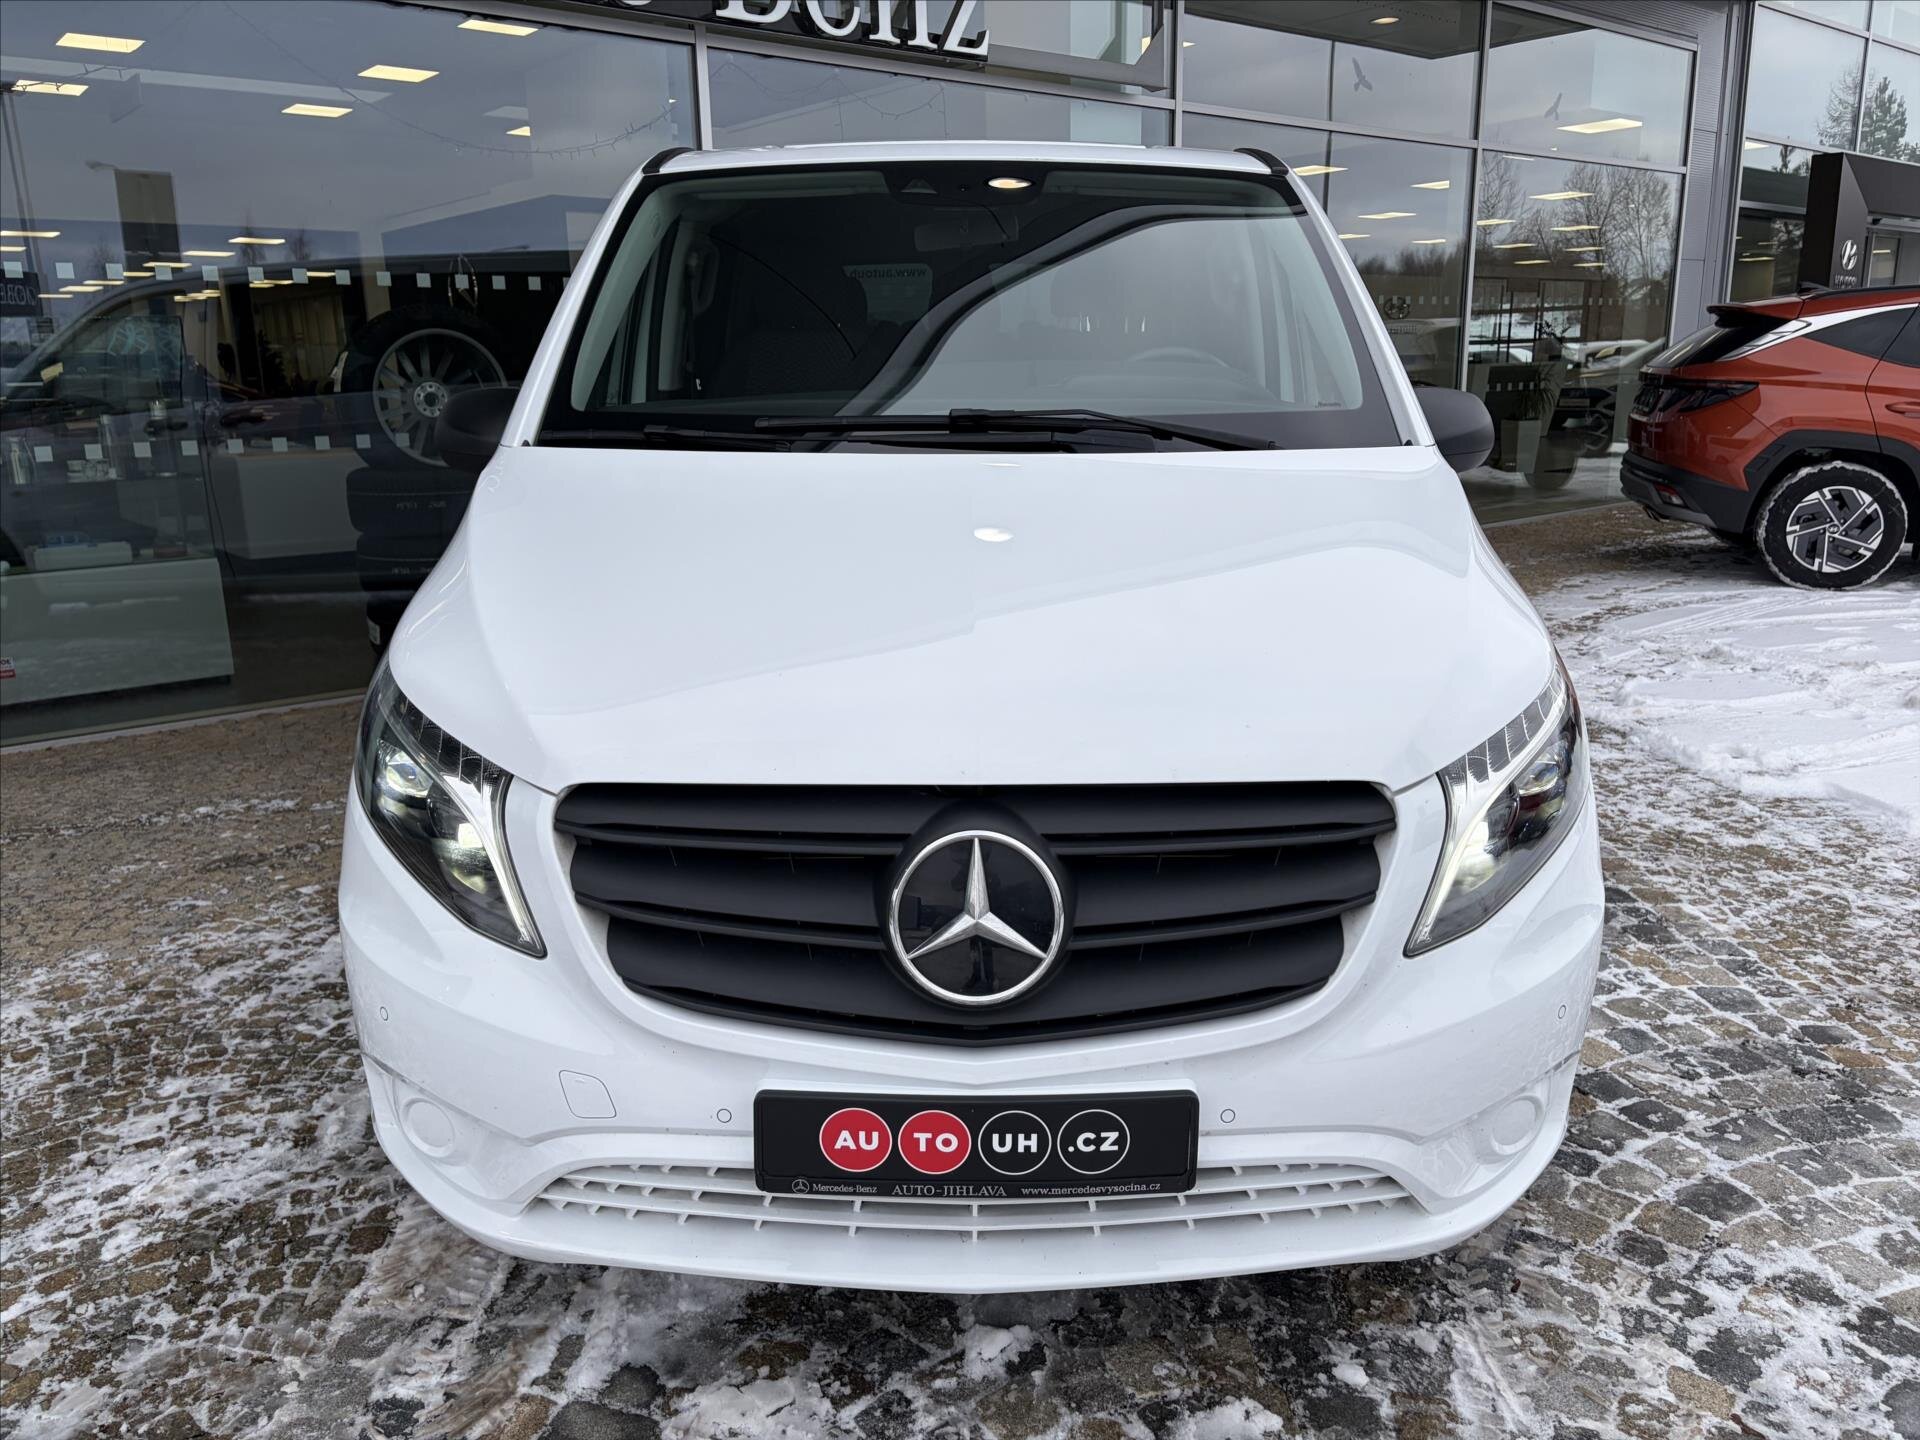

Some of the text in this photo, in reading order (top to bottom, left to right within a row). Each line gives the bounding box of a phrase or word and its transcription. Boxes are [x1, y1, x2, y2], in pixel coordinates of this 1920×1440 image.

[834, 1129, 1120, 1154] AU TO UH .CZ
[812, 1182, 1162, 1197] Mercedes-Benz AUTO-JIHLAVA www.mercedesvysocina.cz
